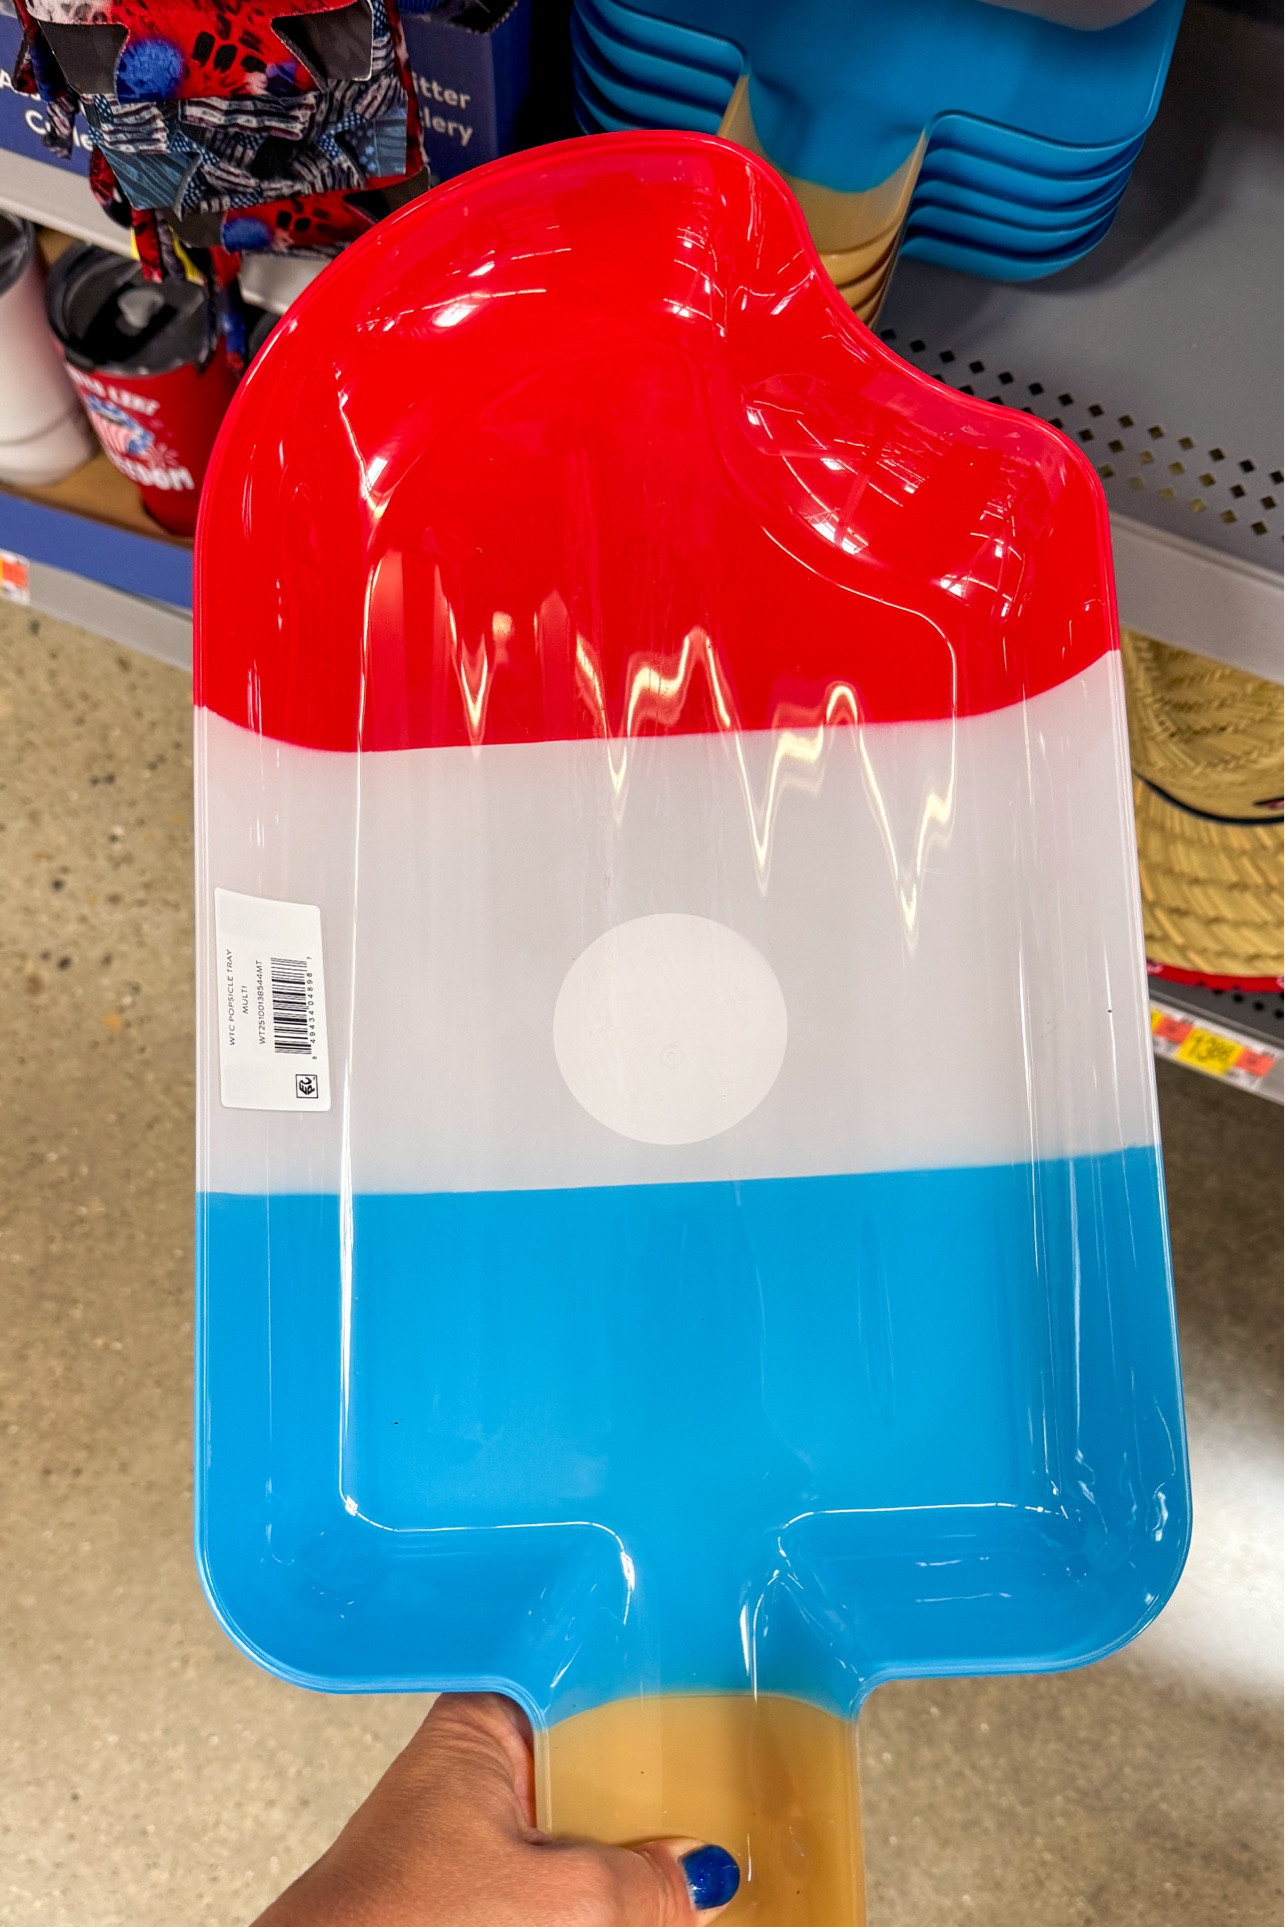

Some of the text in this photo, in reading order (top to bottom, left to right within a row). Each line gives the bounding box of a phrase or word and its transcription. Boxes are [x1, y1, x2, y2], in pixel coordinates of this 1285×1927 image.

[411, 71, 471, 110] itter
[420, 106, 473, 147] lery
[227, 976, 235, 1021] POPSICLE
[241, 985, 249, 1014] MULTI
[256, 960, 266, 1044] WT25100138544MT
[306, 972, 314, 1006] 04898
[308, 1010, 316, 1044] 49434
